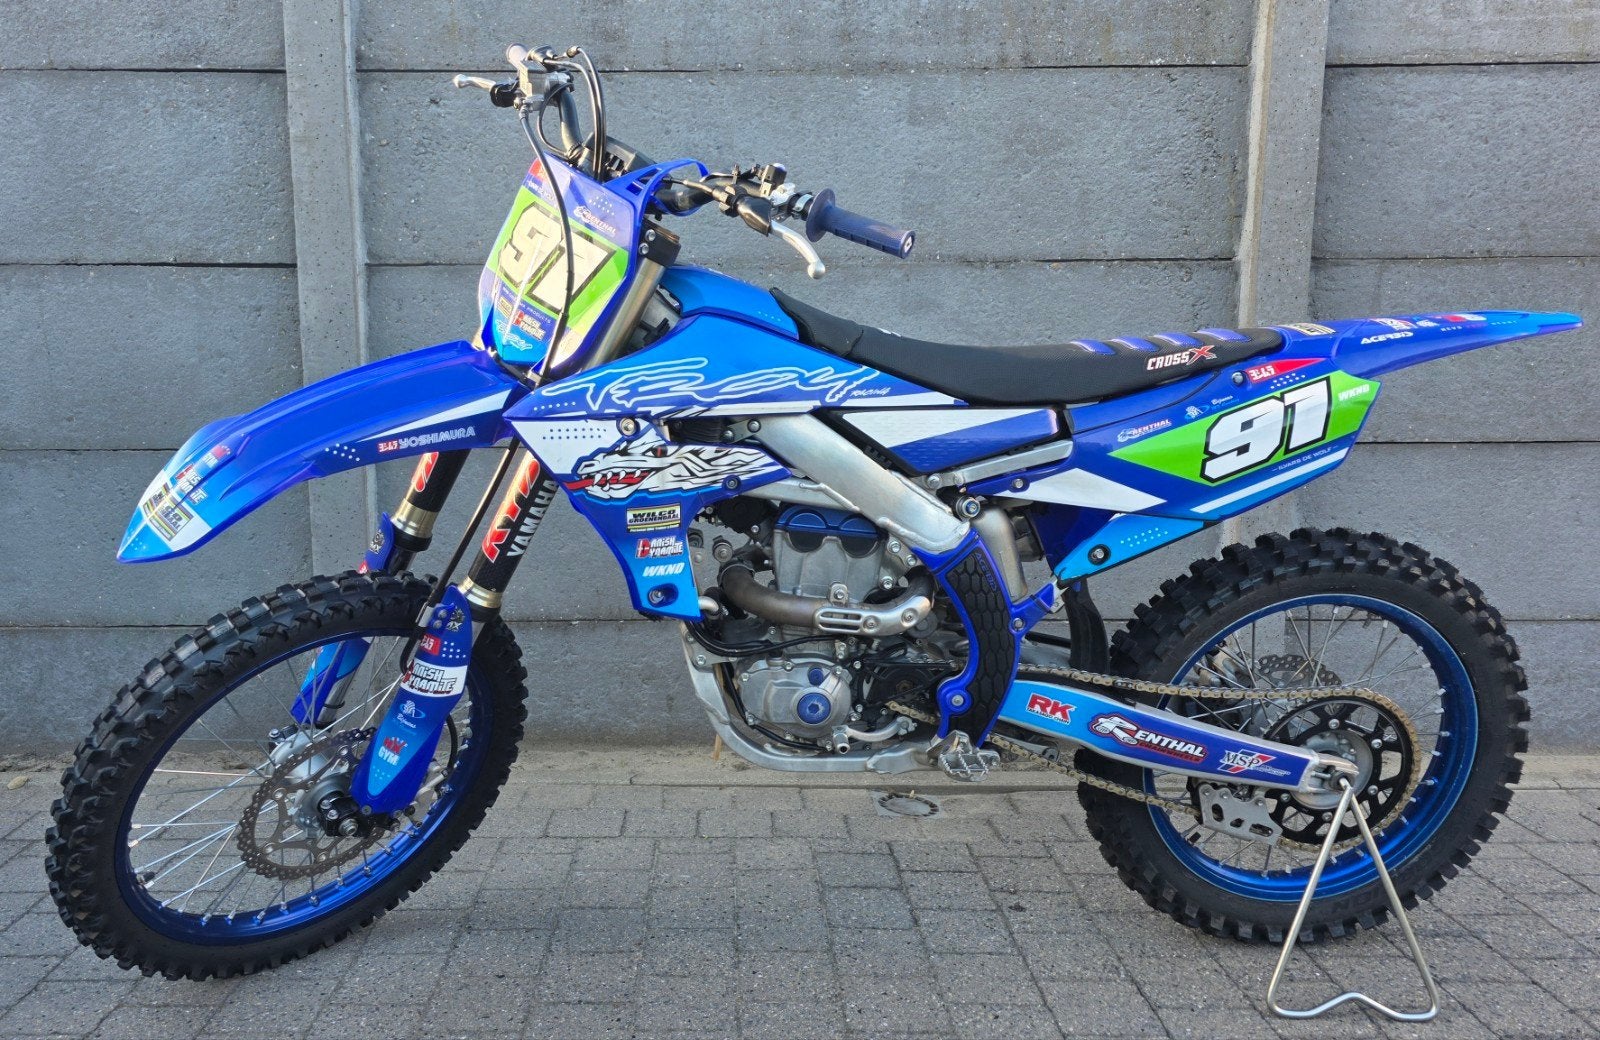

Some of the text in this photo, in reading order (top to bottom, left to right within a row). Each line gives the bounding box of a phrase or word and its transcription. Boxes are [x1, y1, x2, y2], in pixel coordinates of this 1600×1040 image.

[1338, 384, 1370, 402] WKND
[399, 426, 476, 449] YOSHIMURA
[506, 479, 561, 558] YAMAHA
[632, 509, 676, 519] WILCO
[642, 562, 686, 577] WKND
[1027, 693, 1074, 721] RK
[1092, 716, 1205, 758] RENTHAL
[378, 745, 400, 766] GYM
